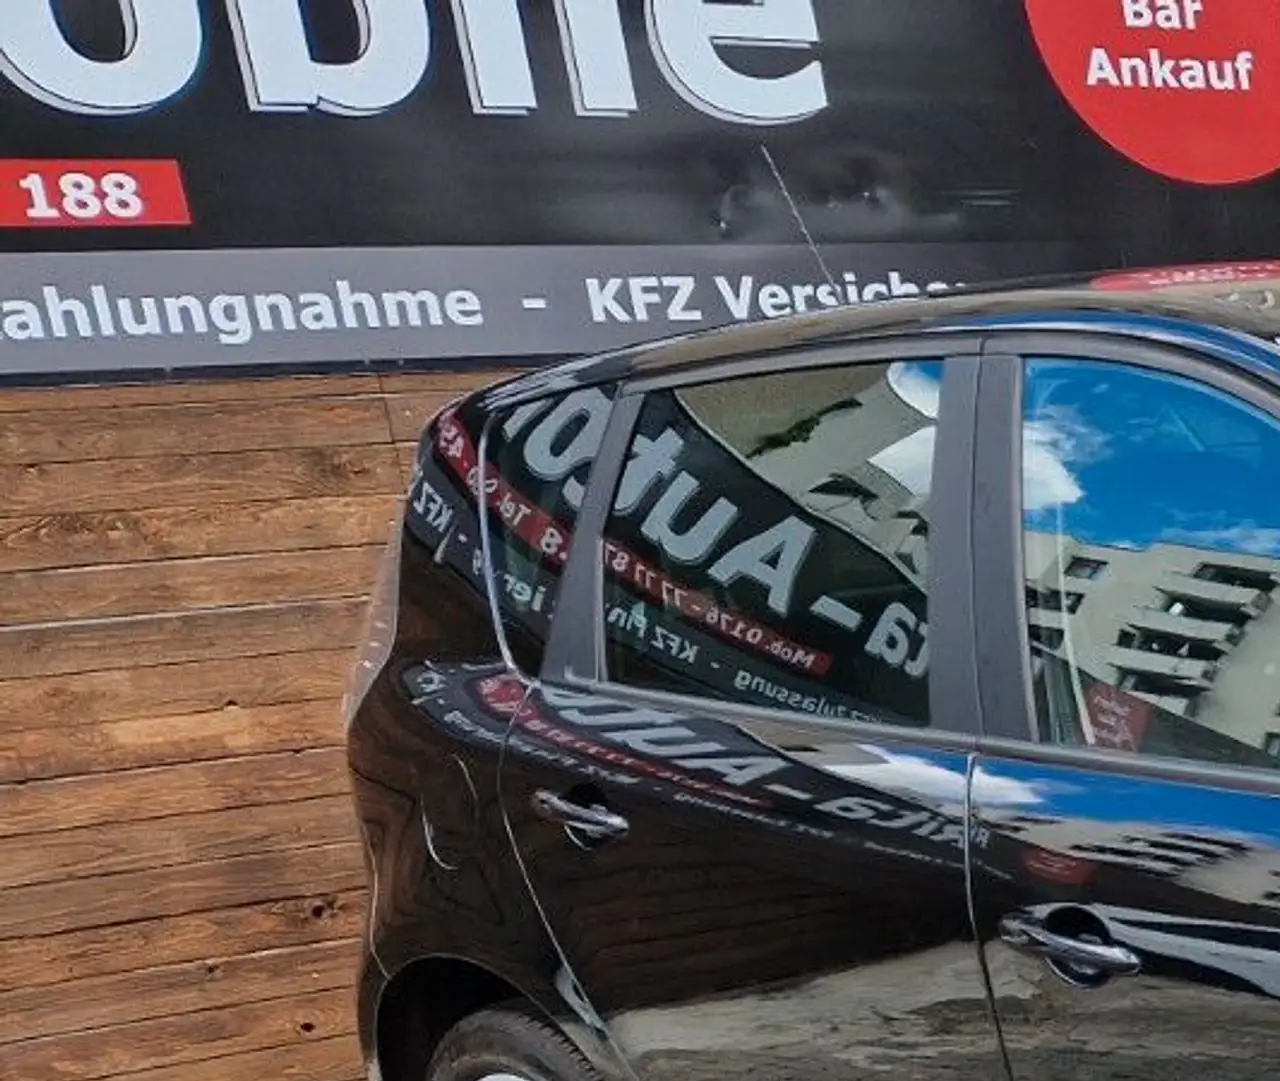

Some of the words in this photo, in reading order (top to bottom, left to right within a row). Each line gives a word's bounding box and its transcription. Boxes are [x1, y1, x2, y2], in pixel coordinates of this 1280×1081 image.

[1123, 0, 1204, 31] Bar
[1086, 47, 1254, 91] Ankauf
[19, 173, 144, 218] 188
[0, 279, 483, 346] ahlungnahme
[587, 274, 702, 326] KFZ
[714, 271, 967, 319] Versich
